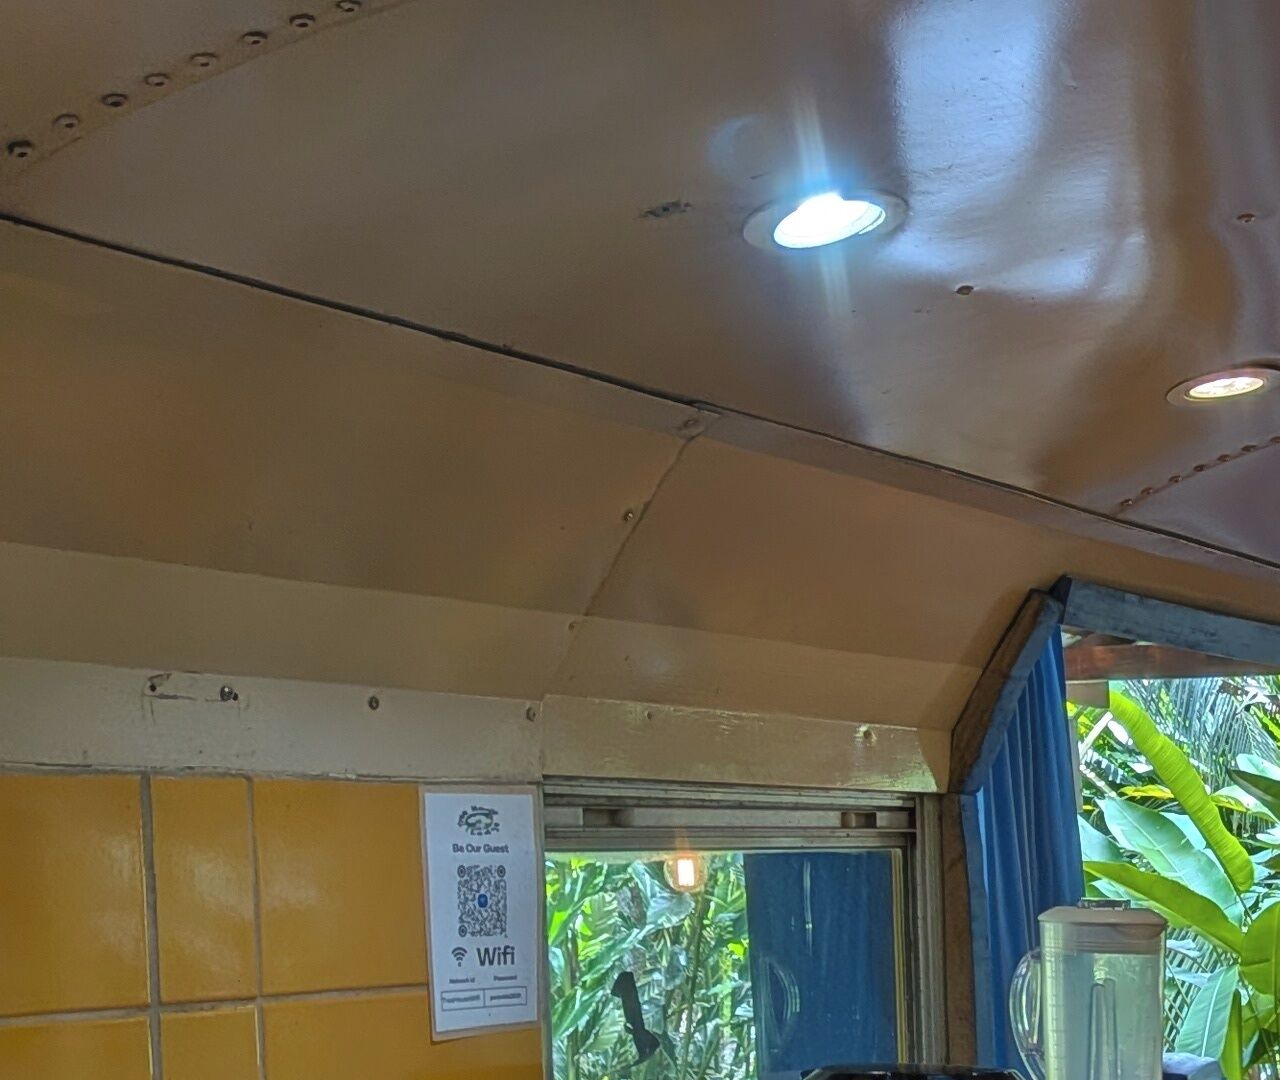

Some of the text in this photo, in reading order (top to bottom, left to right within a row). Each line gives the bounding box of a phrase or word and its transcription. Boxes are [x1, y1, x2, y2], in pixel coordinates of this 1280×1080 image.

[452, 843, 509, 854] Be Our Guest
[476, 944, 515, 967] Wifi
